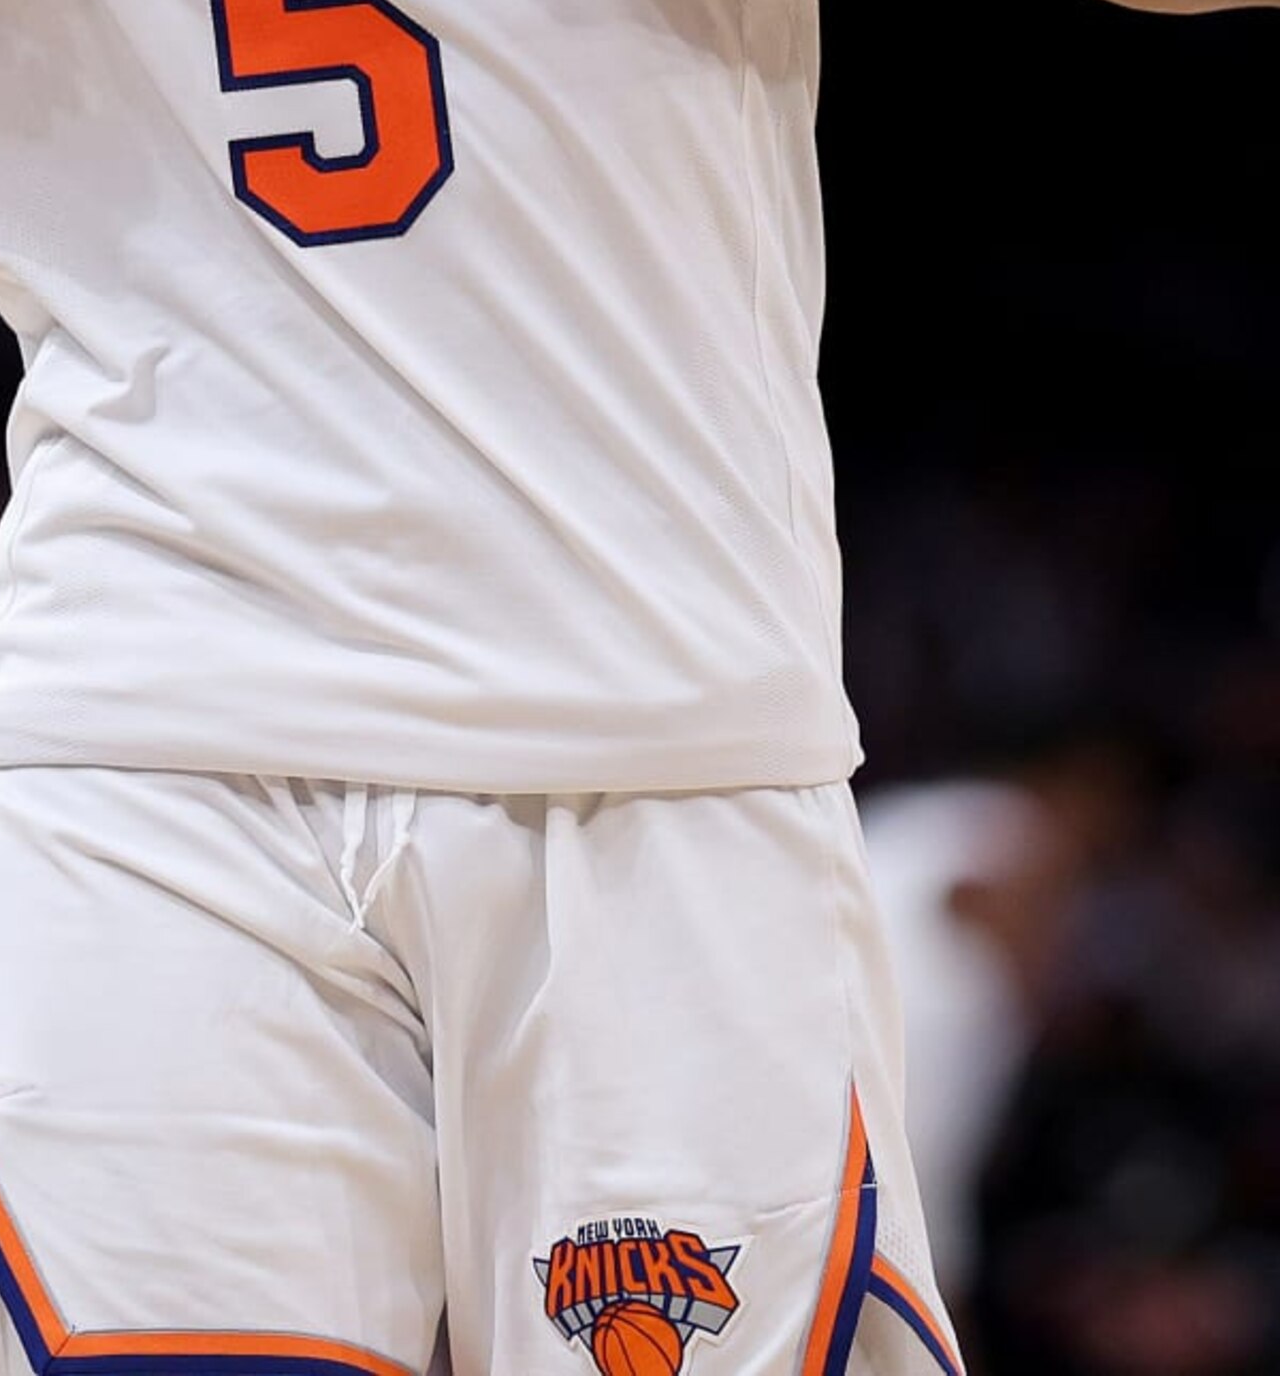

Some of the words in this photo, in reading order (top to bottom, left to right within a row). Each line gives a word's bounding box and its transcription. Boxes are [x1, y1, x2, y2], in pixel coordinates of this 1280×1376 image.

[577, 1222, 609, 1243] NEW
[614, 1218, 662, 1239] YORK
[546, 1229, 740, 1319] KNICKS
